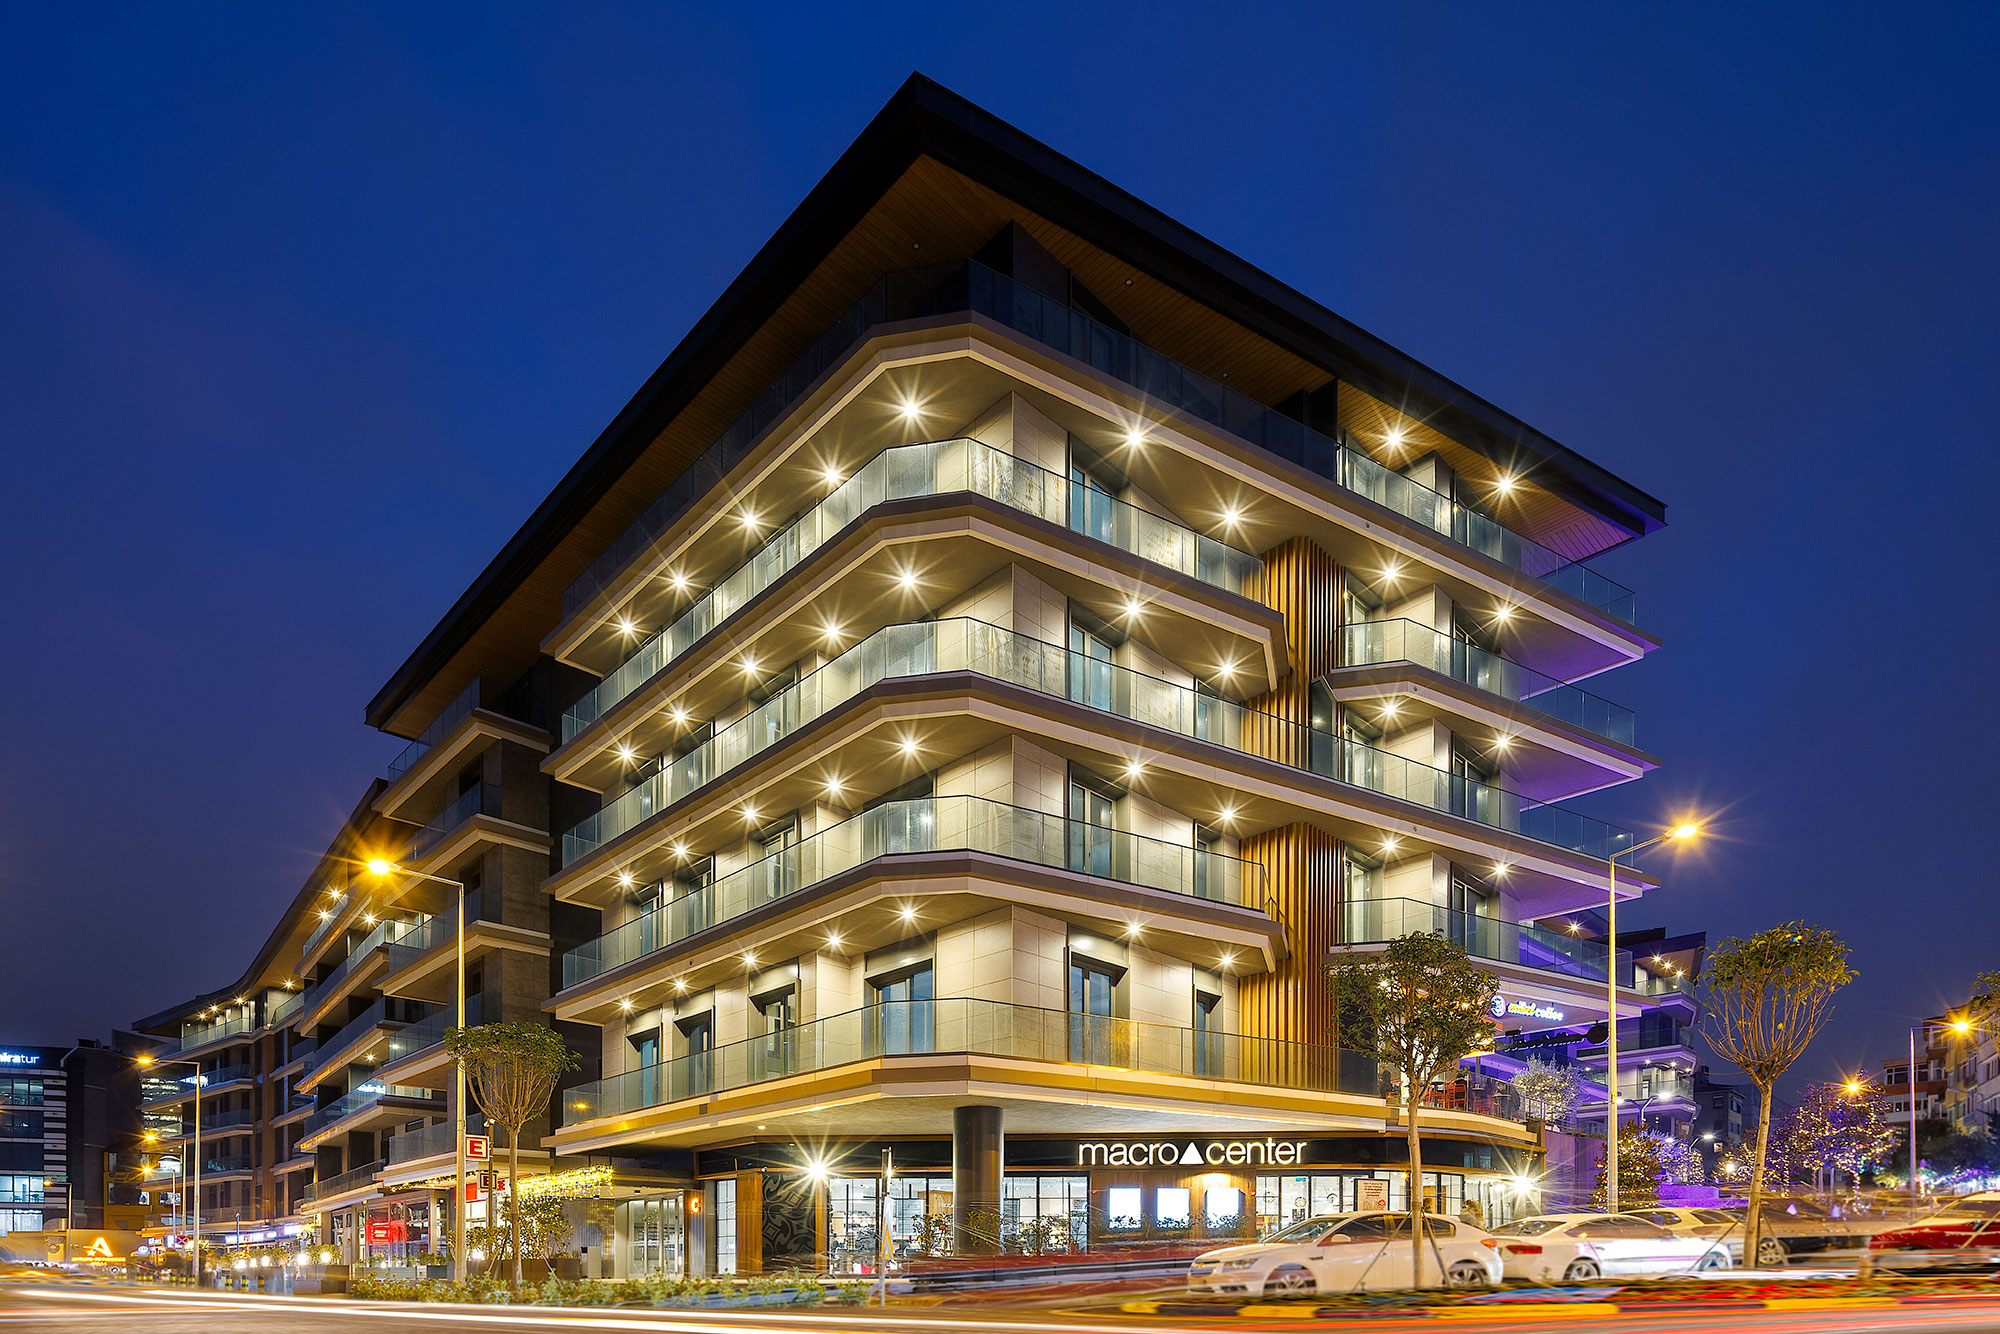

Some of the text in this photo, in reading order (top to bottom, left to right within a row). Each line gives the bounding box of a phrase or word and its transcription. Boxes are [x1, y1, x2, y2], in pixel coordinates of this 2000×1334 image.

[470, 1140, 482, 1155] E
[1078, 1137, 1307, 1166] macro center
